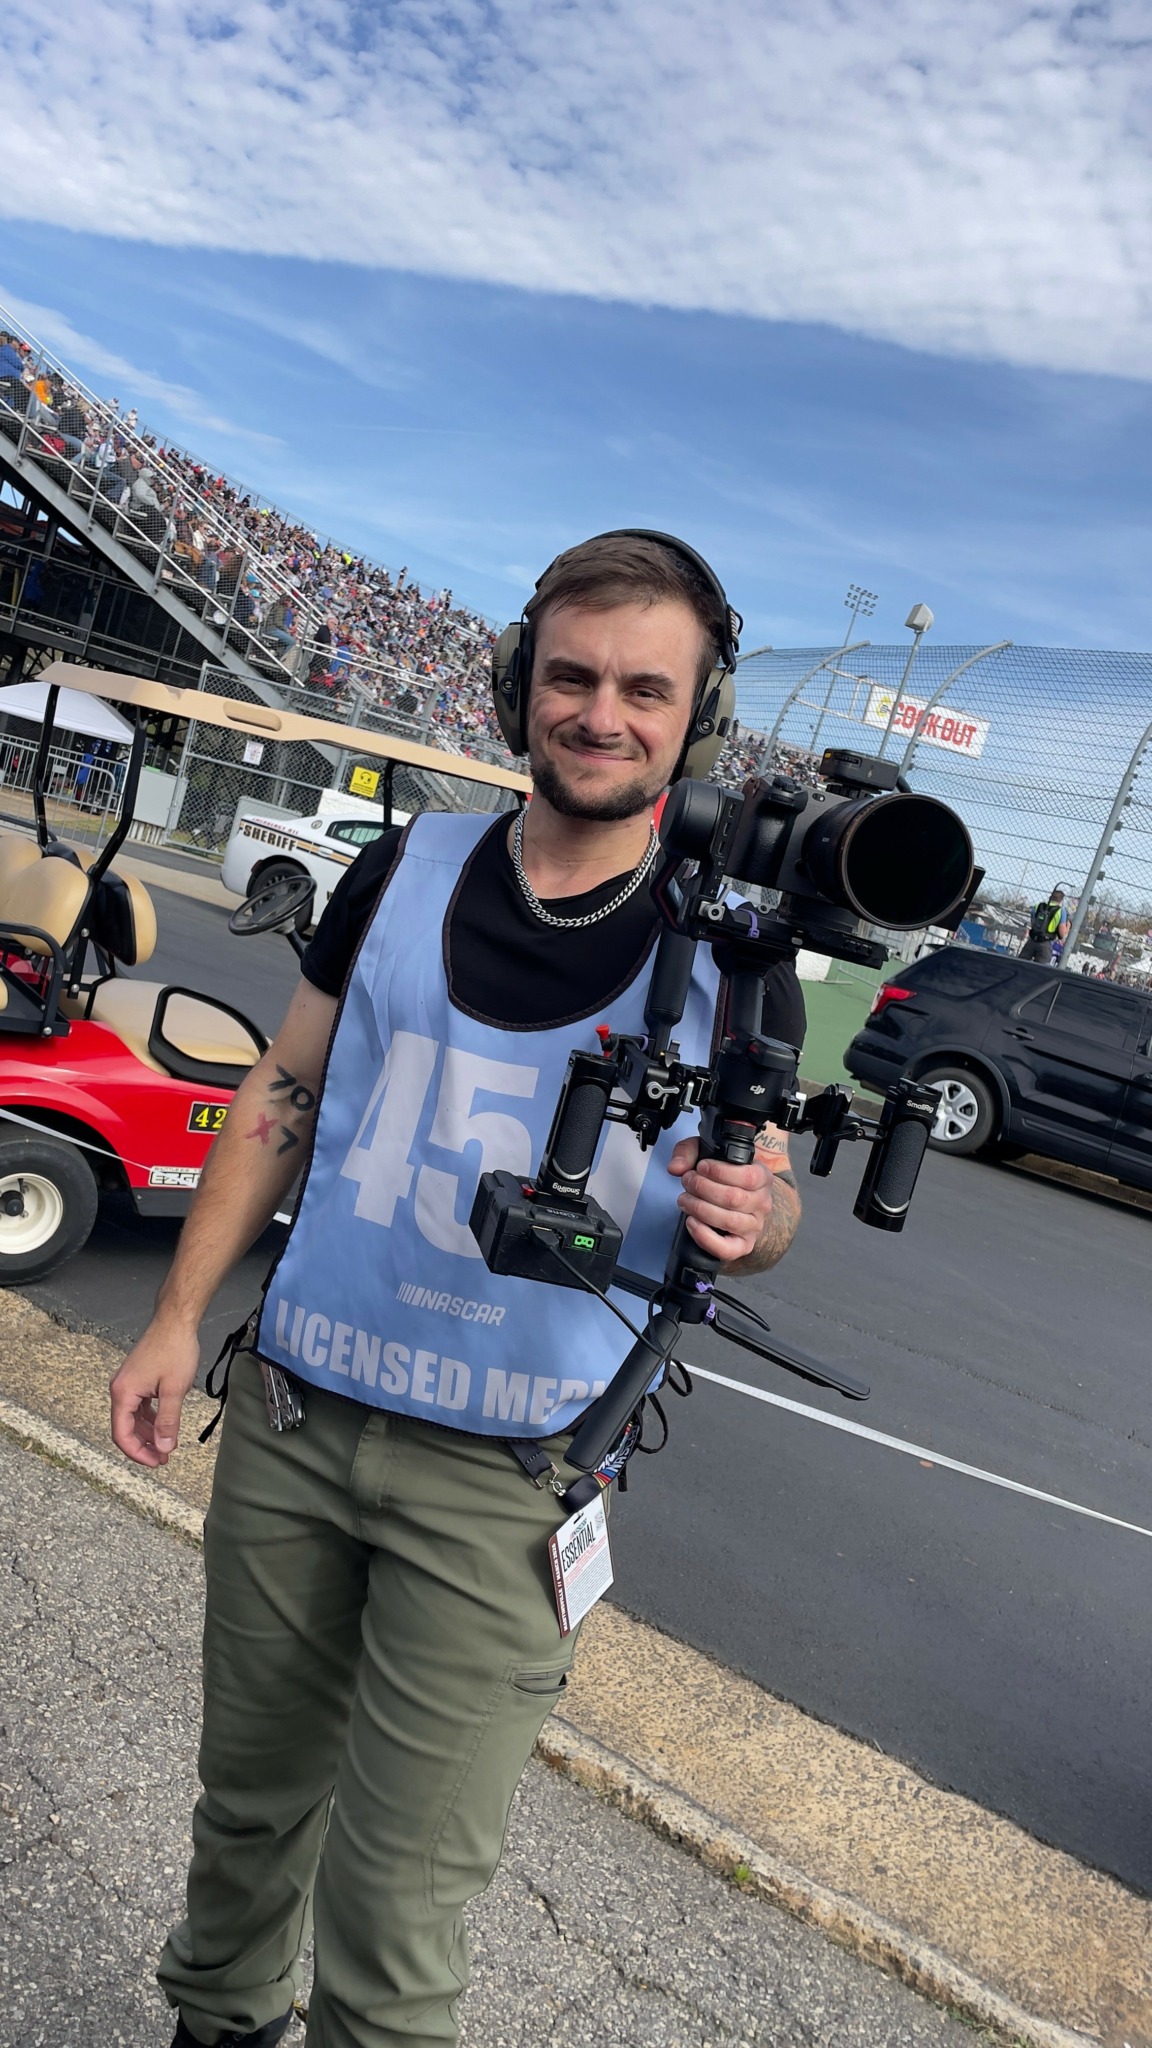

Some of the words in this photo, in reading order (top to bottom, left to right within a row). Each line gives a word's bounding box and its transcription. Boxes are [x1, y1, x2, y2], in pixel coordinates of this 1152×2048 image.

[941, 718, 978, 748] OUT
[243, 824, 297, 852] SHERIFF
[906, 1099, 934, 1114] SmallRig
[150, 1171, 199, 1186] EZG
[552, 1182, 581, 1196] SmallRig
[413, 1286, 507, 1327] NASCAR
[275, 1298, 472, 1412] LICENSED
[482, 1367, 607, 1425] MED
[561, 1520, 596, 1572] ESSENTIAL
